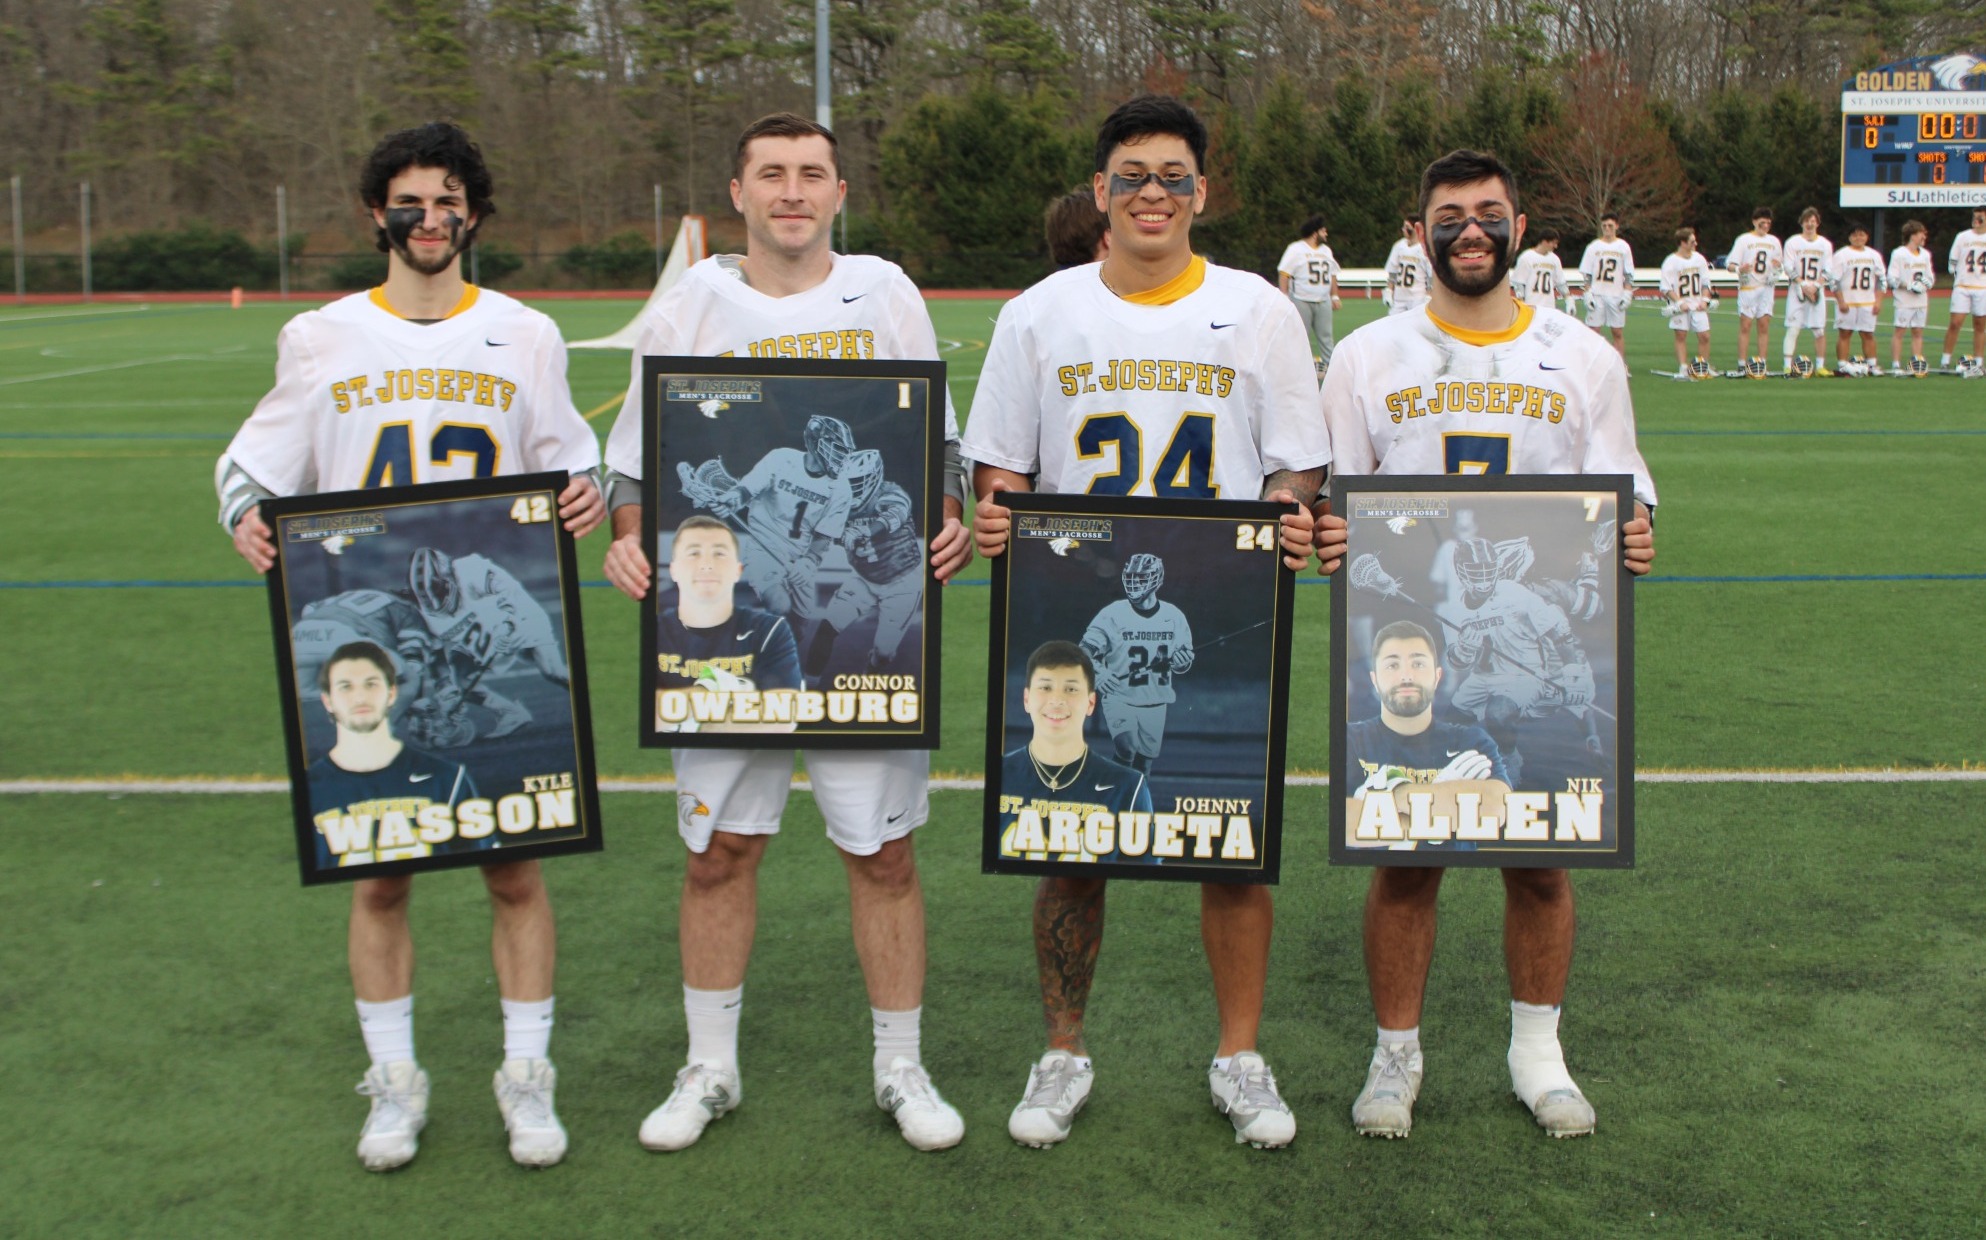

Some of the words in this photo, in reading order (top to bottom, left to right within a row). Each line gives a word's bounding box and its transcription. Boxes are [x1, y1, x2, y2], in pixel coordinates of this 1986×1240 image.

[1856, 72, 1931, 91] GOLDEN
[1851, 98, 1867, 106] ST.
[1871, 98, 1922, 106] JOSEPH'S
[1865, 127, 1878, 148] 0
[1918, 152, 1946, 163] SHOTS
[1933, 163, 1945, 184] 0
[1308, 261, 1330, 285] 52
[1596, 258, 1617, 282] 12
[1755, 250, 1766, 273] 8
[1800, 257, 1819, 280] 15
[1966, 250, 1986, 273] 44
[1397, 263, 1416, 287] 26
[1533, 270, 1551, 294] 10
[1679, 273, 1700, 297] 20
[1851, 267, 1871, 290] 18
[695, 380, 761, 392] JOSEPH'S
[897, 382, 911, 408] 1
[1074, 410, 1221, 500] 24
[510, 496, 552, 524] 42
[1381, 497, 1448, 509] JOSEPH'S
[1583, 496, 1602, 522] 7
[315, 513, 384, 530] JOSEPH'S
[788, 500, 808, 539] 1
[1044, 518, 1113, 532] JOSEPH'S
[300, 530, 329, 539] MEN'S
[331, 526, 377, 536] LACROSSE
[1059, 531, 1104, 539] LACROSSE
[1235, 523, 1275, 550] 24
[1128, 644, 1170, 687] 24
[833, 674, 915, 691] CONNOR
[659, 690, 920, 723] OWENBURG
[522, 773, 574, 793] KYLE
[1566, 778, 1603, 793] NIK
[1174, 797, 1252, 814] JOHNNY
[1355, 791, 1604, 841] ALLEN
[322, 788, 577, 856] WASSON
[1011, 809, 1256, 859] ARGUETA
